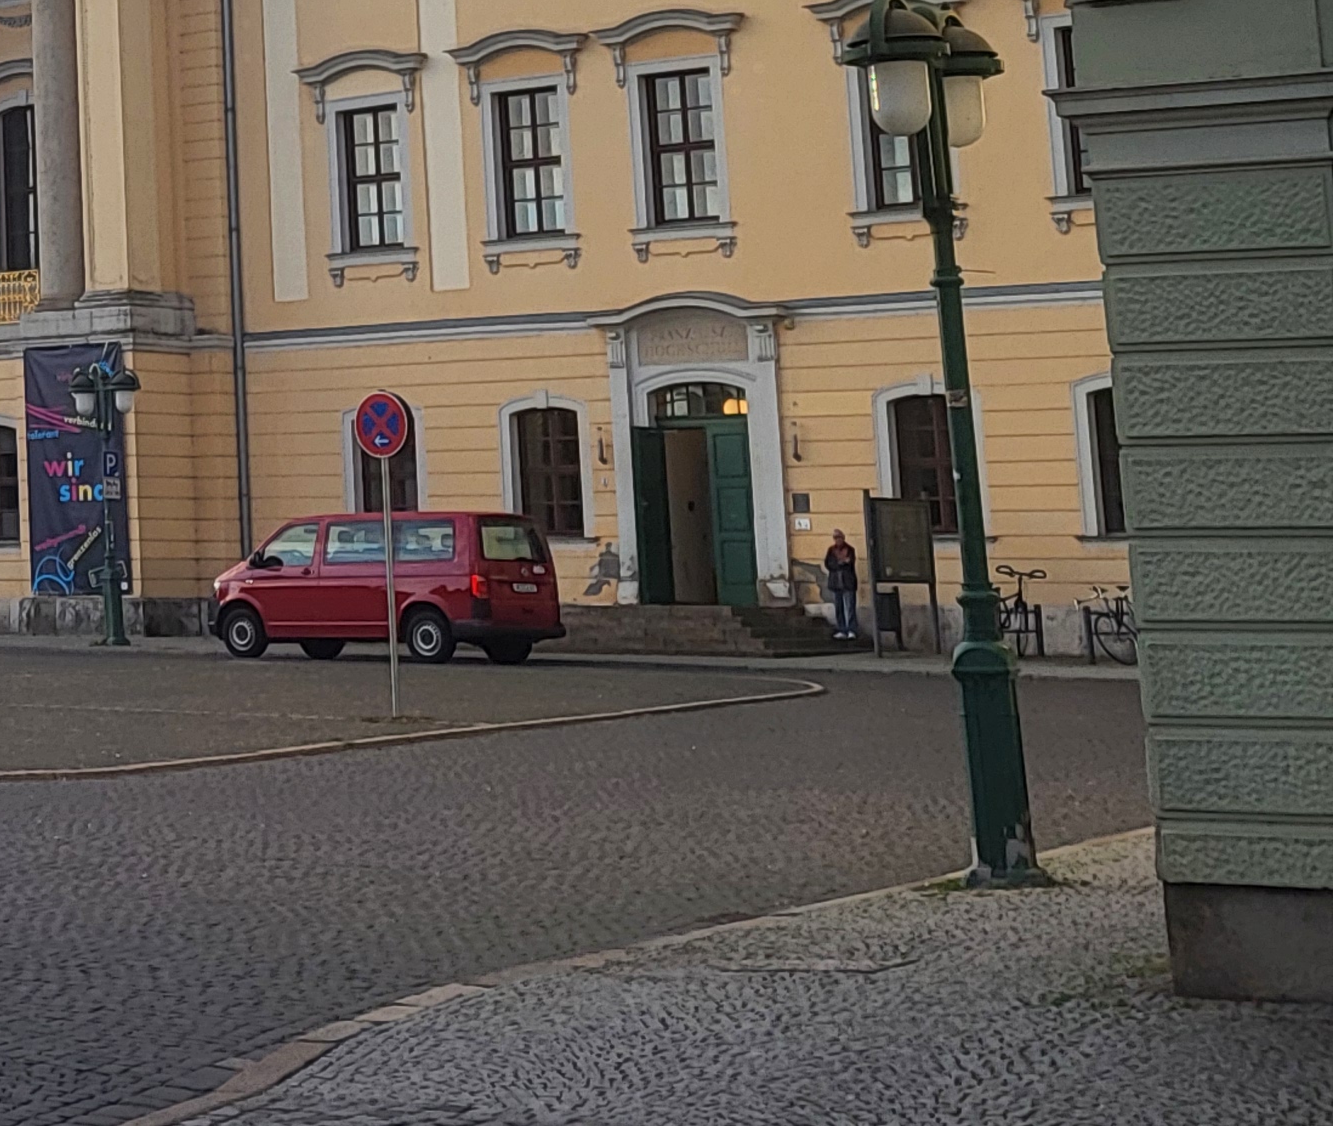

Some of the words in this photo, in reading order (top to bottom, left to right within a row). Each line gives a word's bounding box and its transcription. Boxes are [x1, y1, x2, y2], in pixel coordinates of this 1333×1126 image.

[64, 416, 112, 431] verbind
[44, 452, 85, 478] wir
[106, 453, 117, 475] P
